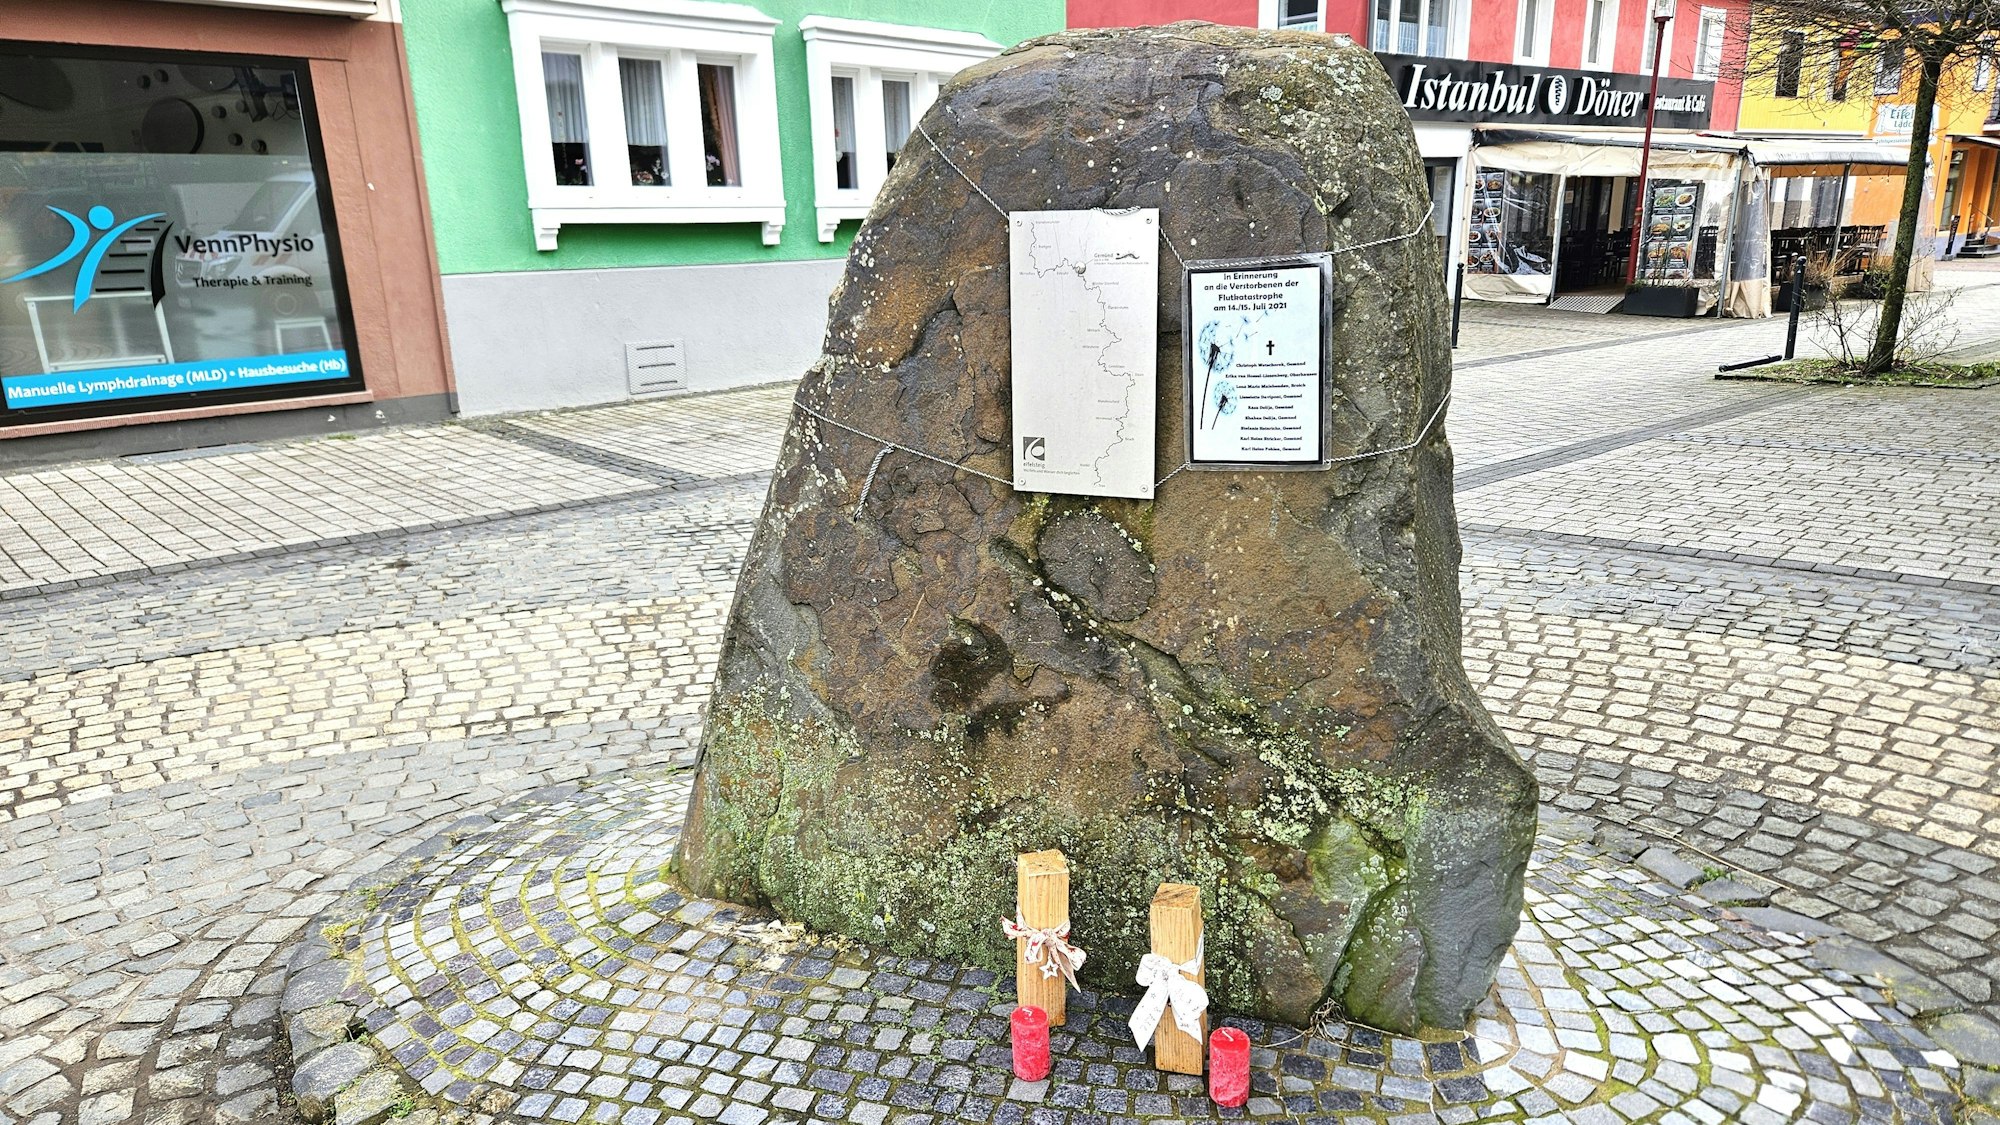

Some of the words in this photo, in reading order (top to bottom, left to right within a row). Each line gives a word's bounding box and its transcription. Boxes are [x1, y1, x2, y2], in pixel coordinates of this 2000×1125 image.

[1404, 63, 1541, 115] Istanbul
[1574, 75, 1644, 118] Döner
[1653, 95, 1685, 111] estaurant
[1692, 94, 1706, 113] Café
[1890, 108, 1914, 119] Eifel
[175, 233, 314, 256] VennPhysio
[193, 276, 248, 288] Therapie
[252, 276, 261, 285] &
[265, 274, 313, 287] Training
[1233, 272, 1278, 280] Erinnerung
[1230, 282, 1283, 290] Verstorbenen
[1218, 292, 1283, 301] Flutkatastrophe
[8, 381, 75, 399] Manuelle
[78, 372, 184, 397] Lymphdrainage
[186, 368, 227, 385] (MLD)
[238, 361, 318, 378] Hausbesuche
[319, 358, 346, 374] (Hb)
